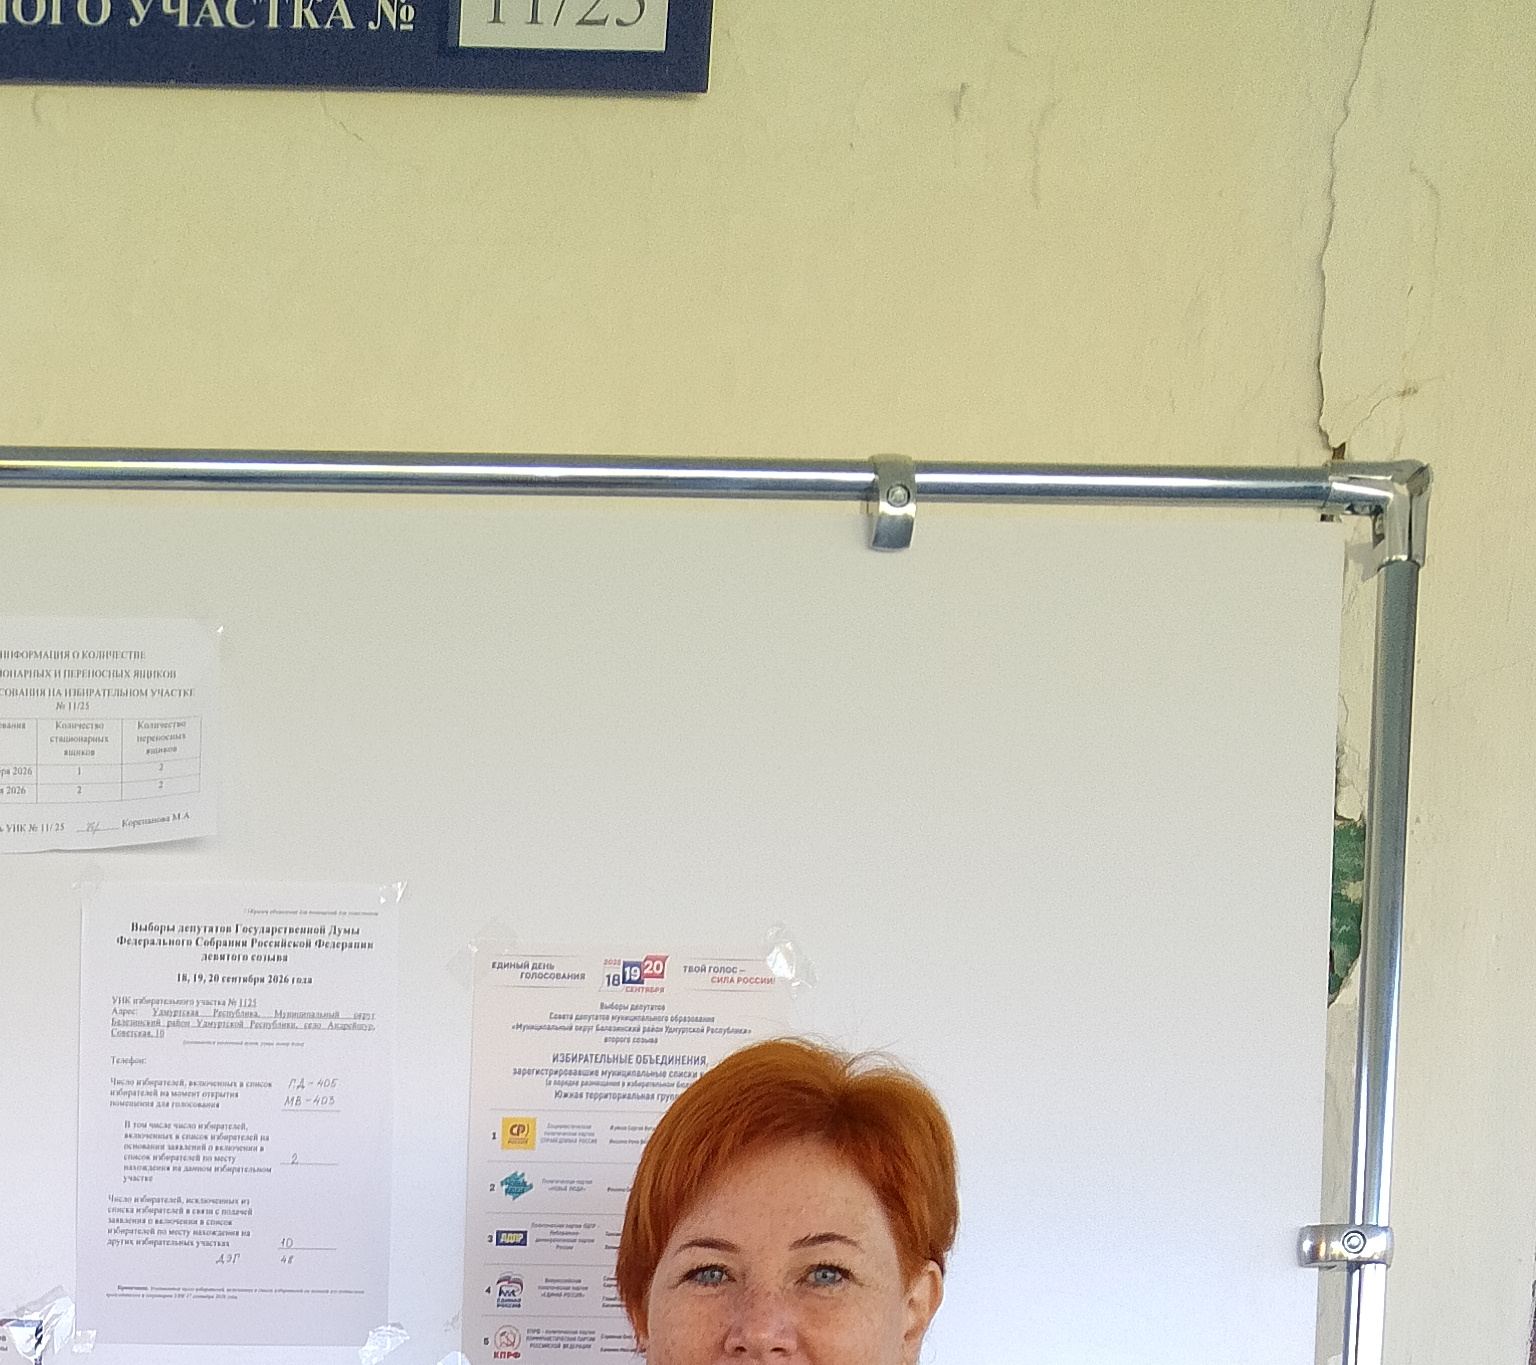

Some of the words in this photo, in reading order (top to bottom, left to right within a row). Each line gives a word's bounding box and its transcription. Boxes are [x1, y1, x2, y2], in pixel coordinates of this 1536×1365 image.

[0, 650, 69, 660] ИНФОРМАЦИЯ
[82, 651, 146, 660] КОЛИЧЕСТВЕ
[64, 670, 130, 679] ПЕРЕНОСНЫХ
[134, 670, 176, 679] ЯЩИКОВ
[65, 688, 148, 697] ИЗБИРАТЕЛЬНОМ
[151, 689, 195, 697] УЧАСТКЕ
[13, 767, 32, 776] 2026
[6, 787, 26, 795] 2026
[131, 922, 175, 933] Выборы
[178, 923, 231, 935] депутатов
[235, 924, 326, 936] Государственной
[329, 925, 360, 937] Думы
[117, 937, 192, 948] Федерального
[195, 937, 247, 949] Собрания
[251, 938, 311, 948] Российской
[492, 961, 529, 970] ЕДИНЫЙ
[531, 963, 555, 971] ДЕНЬ
[683, 965, 706, 973] ТВОЙ
[520, 972, 585, 980] ГОЛОСОВАНИЯ
[606, 973, 620, 986] 18
[625, 966, 640, 979] 19
[644, 961, 662, 974] 20
[711, 976, 734, 984] СИЛА
[552, 1054, 633, 1064] ИЗБИРАТЕЛЬНЫЕ
